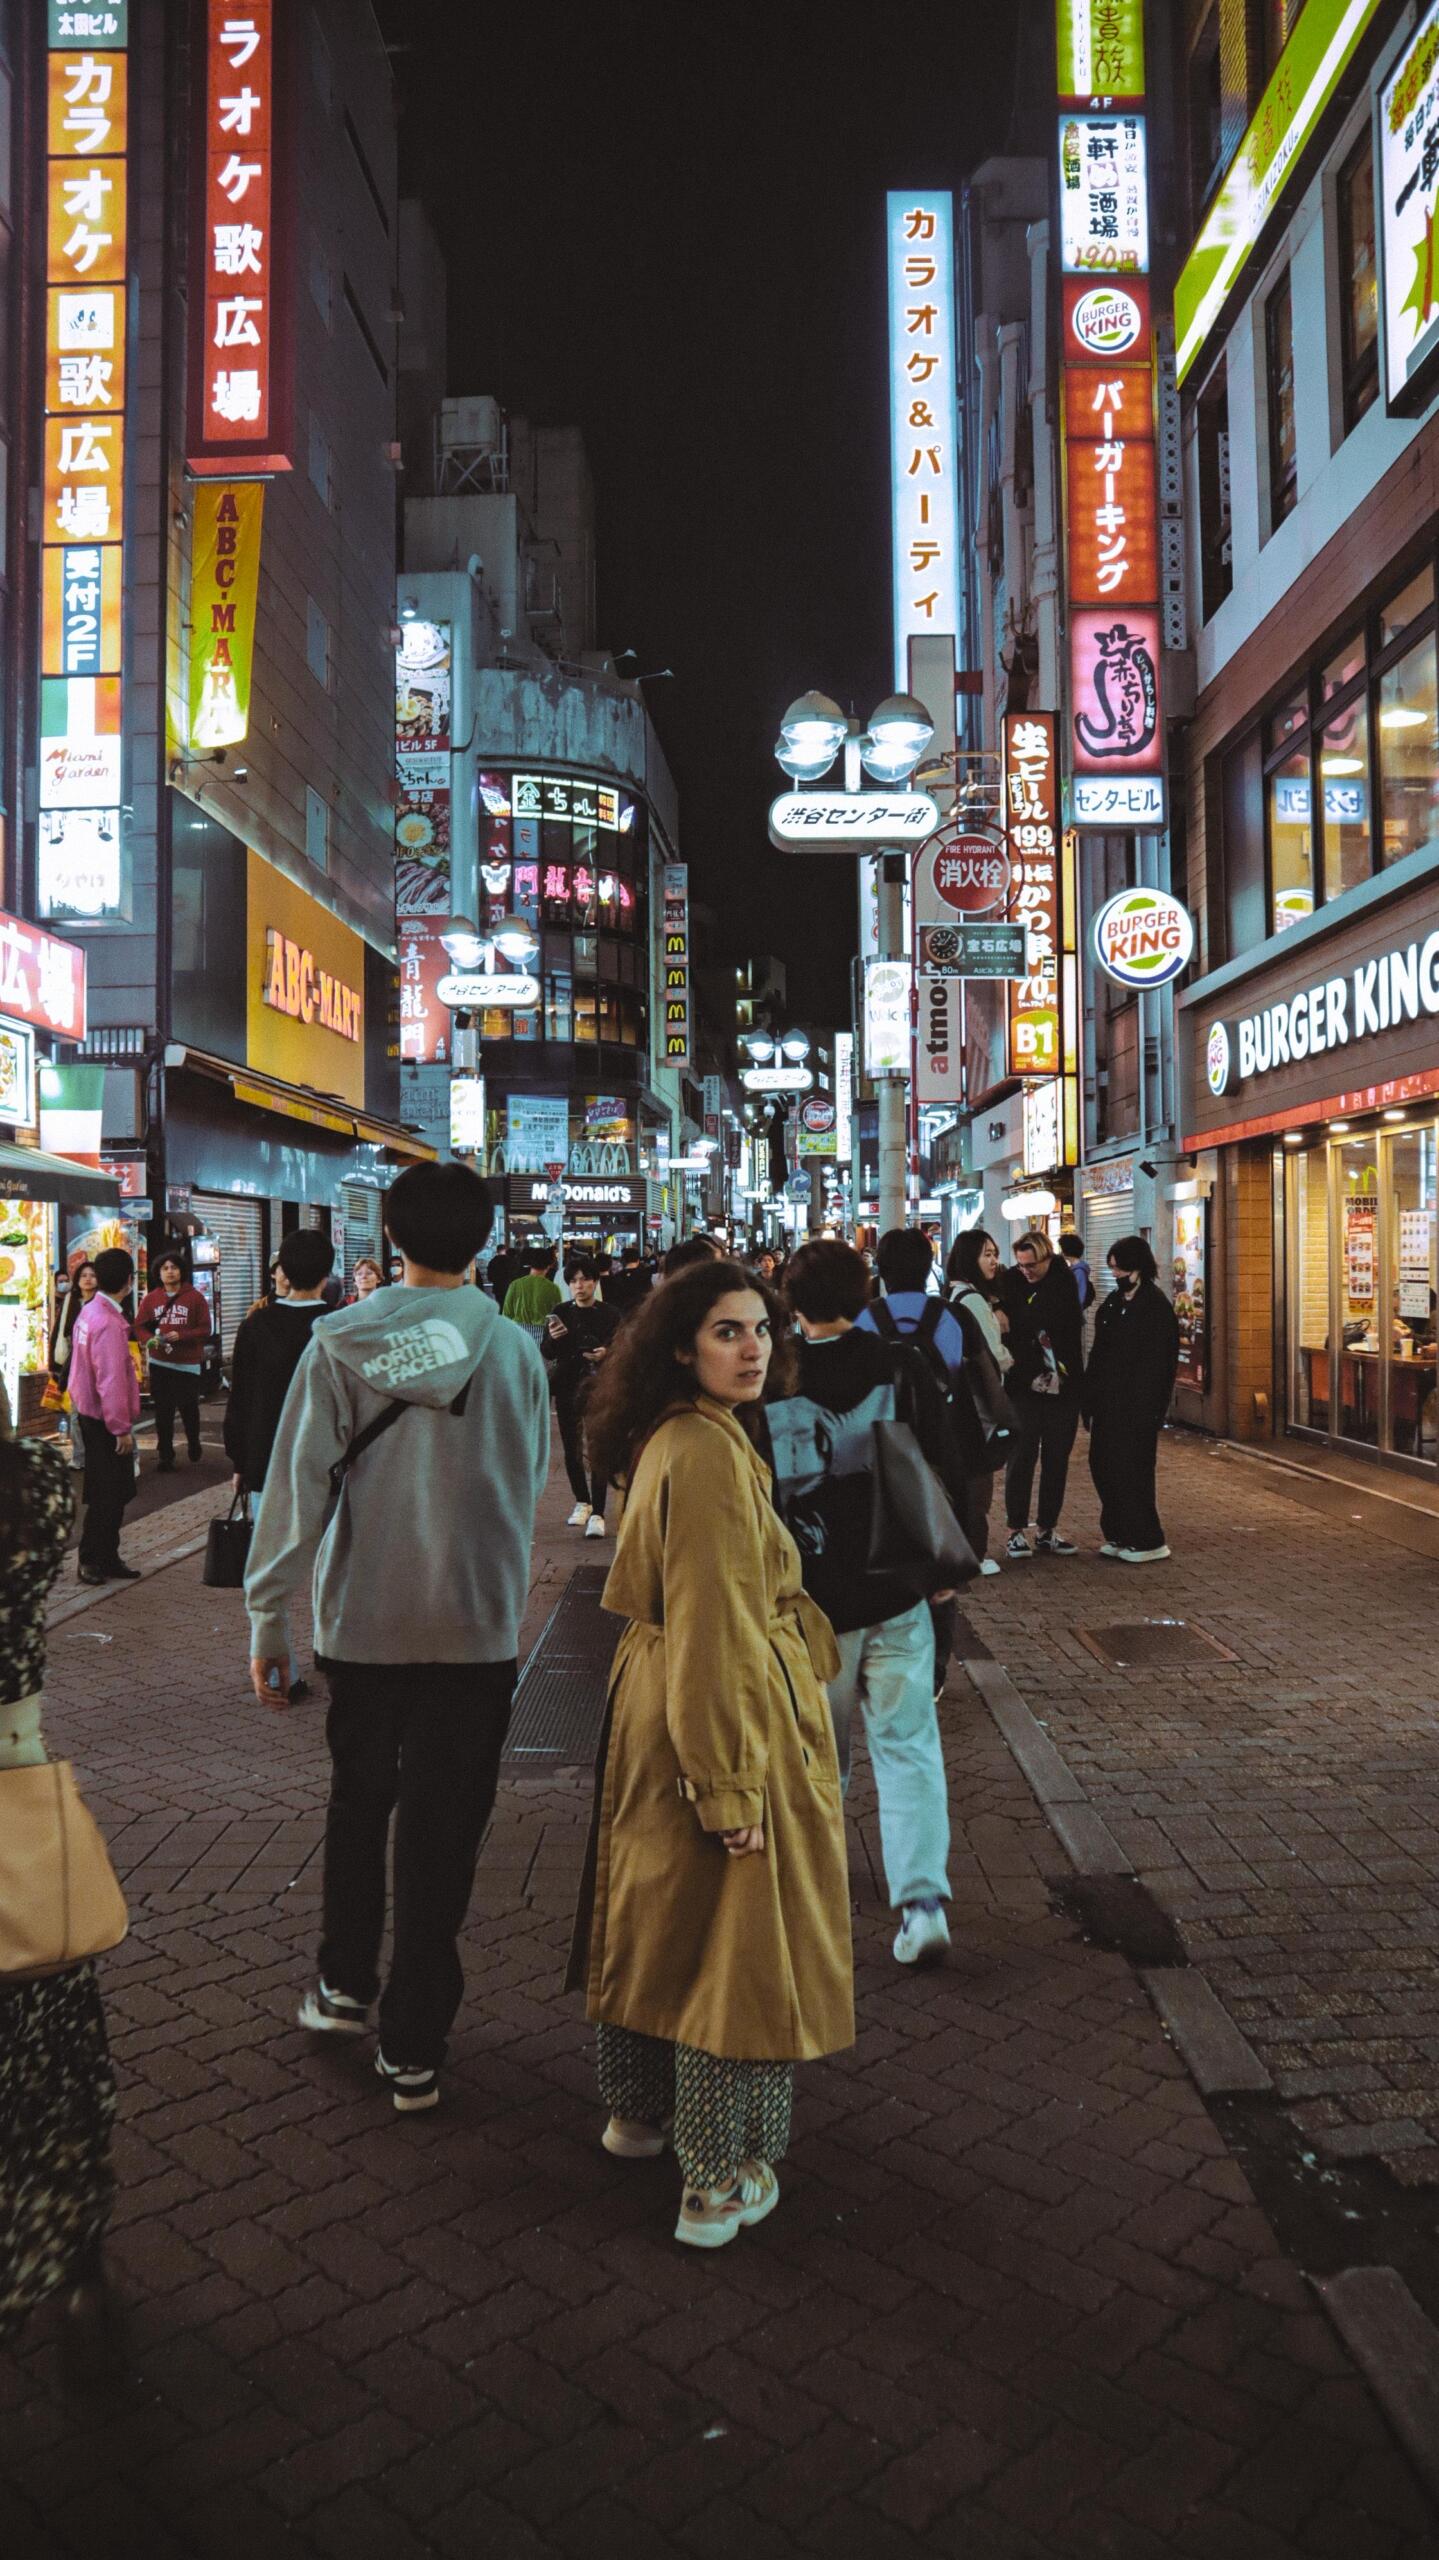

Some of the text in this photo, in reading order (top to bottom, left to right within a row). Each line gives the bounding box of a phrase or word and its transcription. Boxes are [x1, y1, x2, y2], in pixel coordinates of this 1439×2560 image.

[1092, 0, 1125, 84] 貴族
[1089, 97, 1113, 109] 4F
[63, 56, 113, 273] カラオケ
[1086, 122, 1120, 239] 一軒酒場
[213, 0, 263, 421] ラオケ歌広場
[1073, 244, 1139, 272] 190円
[1081, 301, 1130, 323] BURGER
[1084, 313, 1132, 338] KING
[904, 208, 943, 618] カラオケ&パーティ
[56, 355, 112, 538] 歌広場
[1092, 380, 1129, 592] バーガーキング
[65, 549, 100, 671] 受付2F
[397, 739, 421, 751] ビル
[1011, 721, 1050, 820] 生ビール
[517, 782, 598, 816] 金ちゃん
[1075, 787, 1162, 812] センタービル
[781, 807, 931, 826] 渋谷センター街
[945, 844, 996, 854] FIRE HYDRANT
[1010, 824, 1053, 847] 199
[940, 858, 1004, 888] 消火栓
[1107, 910, 1178, 939] BURGER
[966, 938, 1023, 953] 宝石広場
[1109, 926, 1182, 965] KING
[268, 930, 361, 1043] ABC-MART
[400, 943, 428, 1055] 青龍門
[443, 984, 533, 996] 谷センター街
[1015, 976, 1049, 1001] 70
[1239, 930, 1439, 1079] BURGER KING
[1016, 1020, 1053, 1054] B1
[531, 1182, 632, 1203] MDonald's
[1347, 1206, 1377, 1215] ORDE
[383, 1323, 426, 1349] THE
[361, 1338, 432, 1379] NORTH
[387, 1353, 438, 1389] FACE
